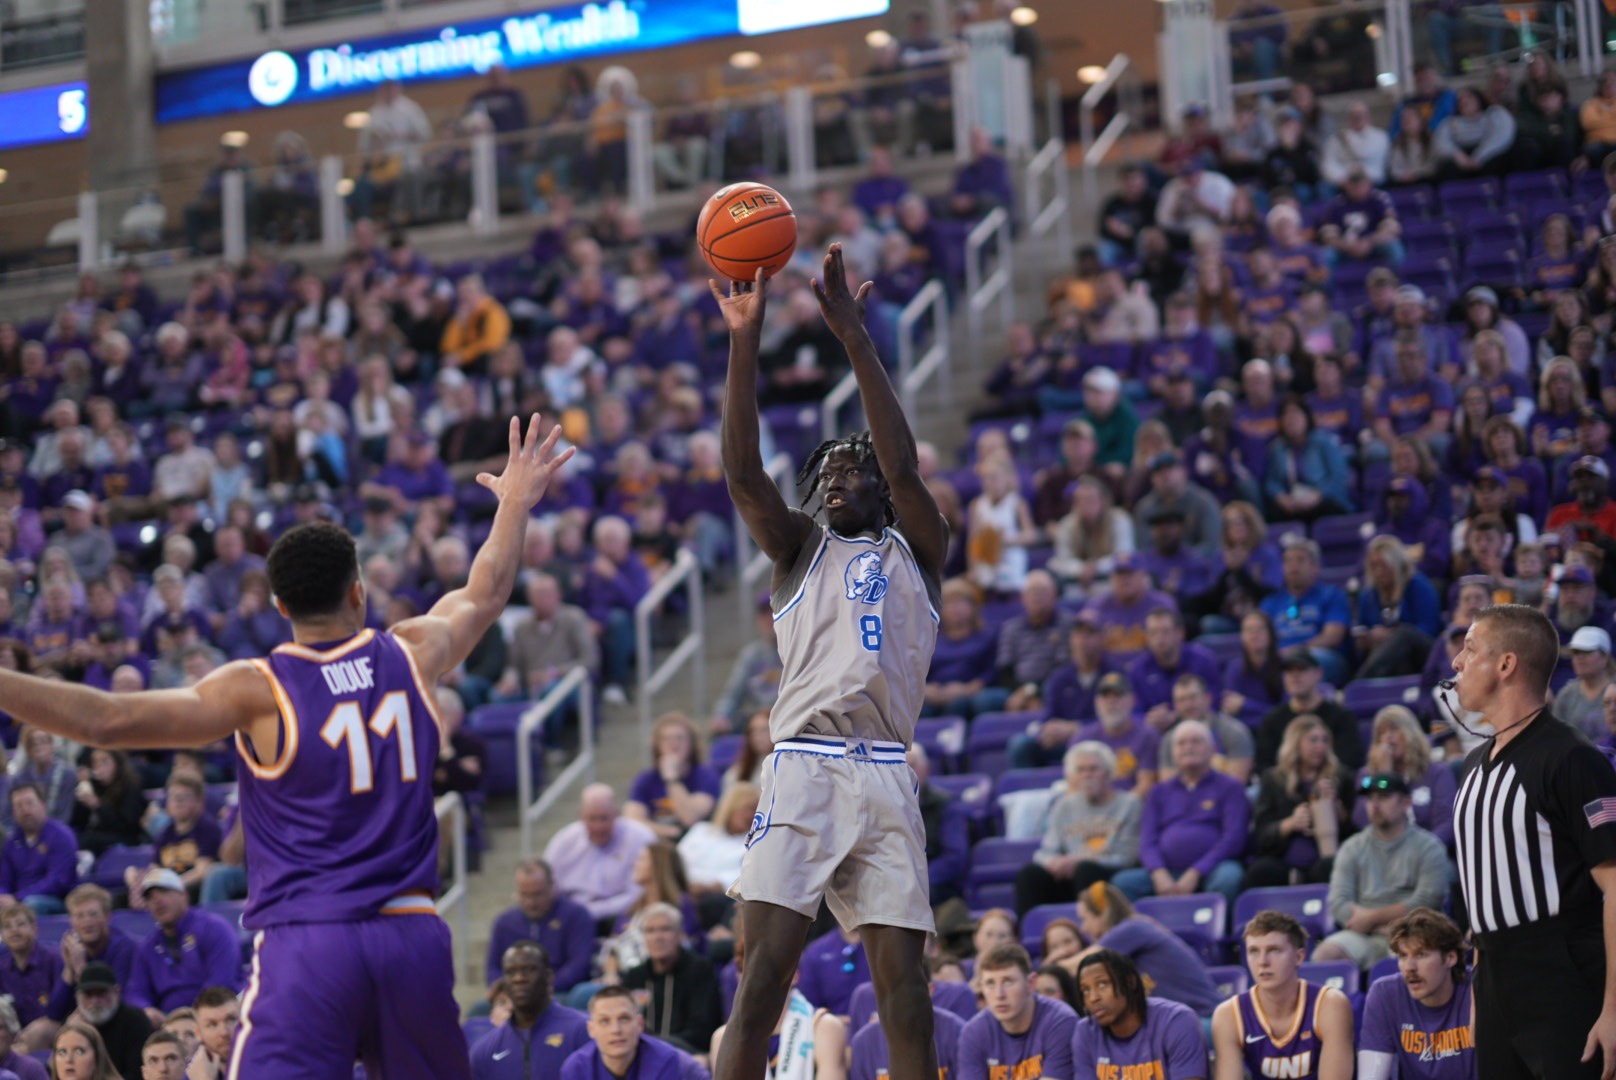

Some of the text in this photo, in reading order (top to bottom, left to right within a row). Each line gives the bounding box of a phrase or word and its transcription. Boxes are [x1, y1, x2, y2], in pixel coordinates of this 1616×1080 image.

[308, 1, 639, 90] Discerning Wealth
[58, 89, 87, 134] 5
[728, 192, 779, 217] ELITE
[859, 614, 882, 652] 8
[320, 656, 374, 695] DIOUF
[319, 690, 417, 794] 11
[1261, 1050, 1312, 1079] UNI
